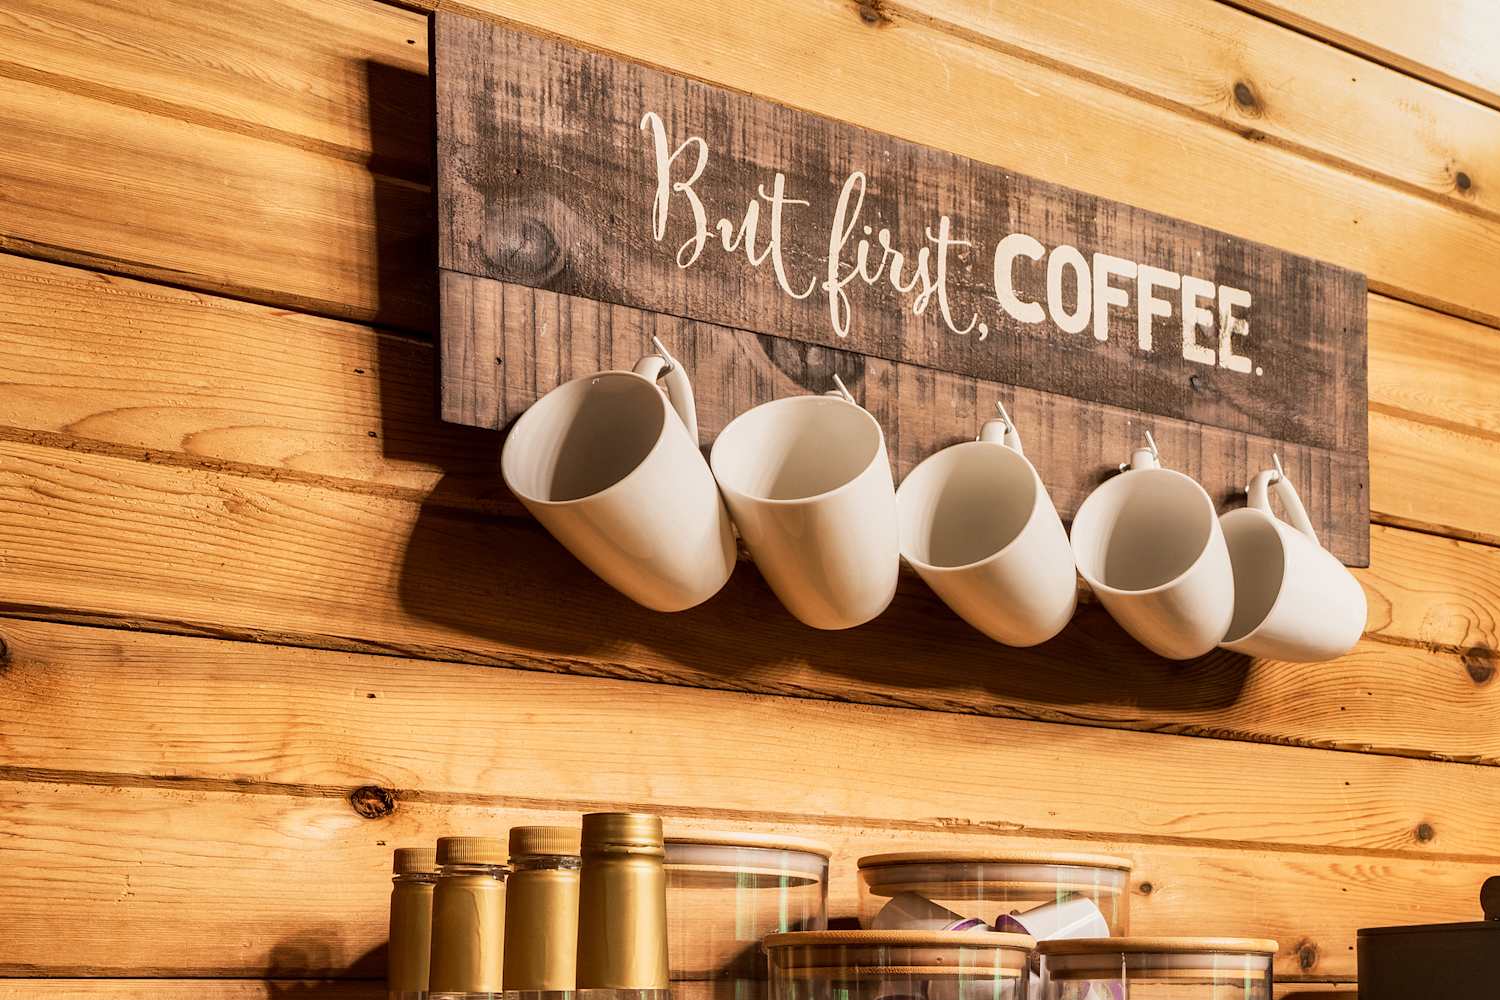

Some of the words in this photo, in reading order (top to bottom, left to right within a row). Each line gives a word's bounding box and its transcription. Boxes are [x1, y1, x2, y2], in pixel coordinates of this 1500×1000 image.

[640, 112, 816, 301] But
[822, 170, 988, 342] first,
[993, 232, 1264, 377] COFFEE.
